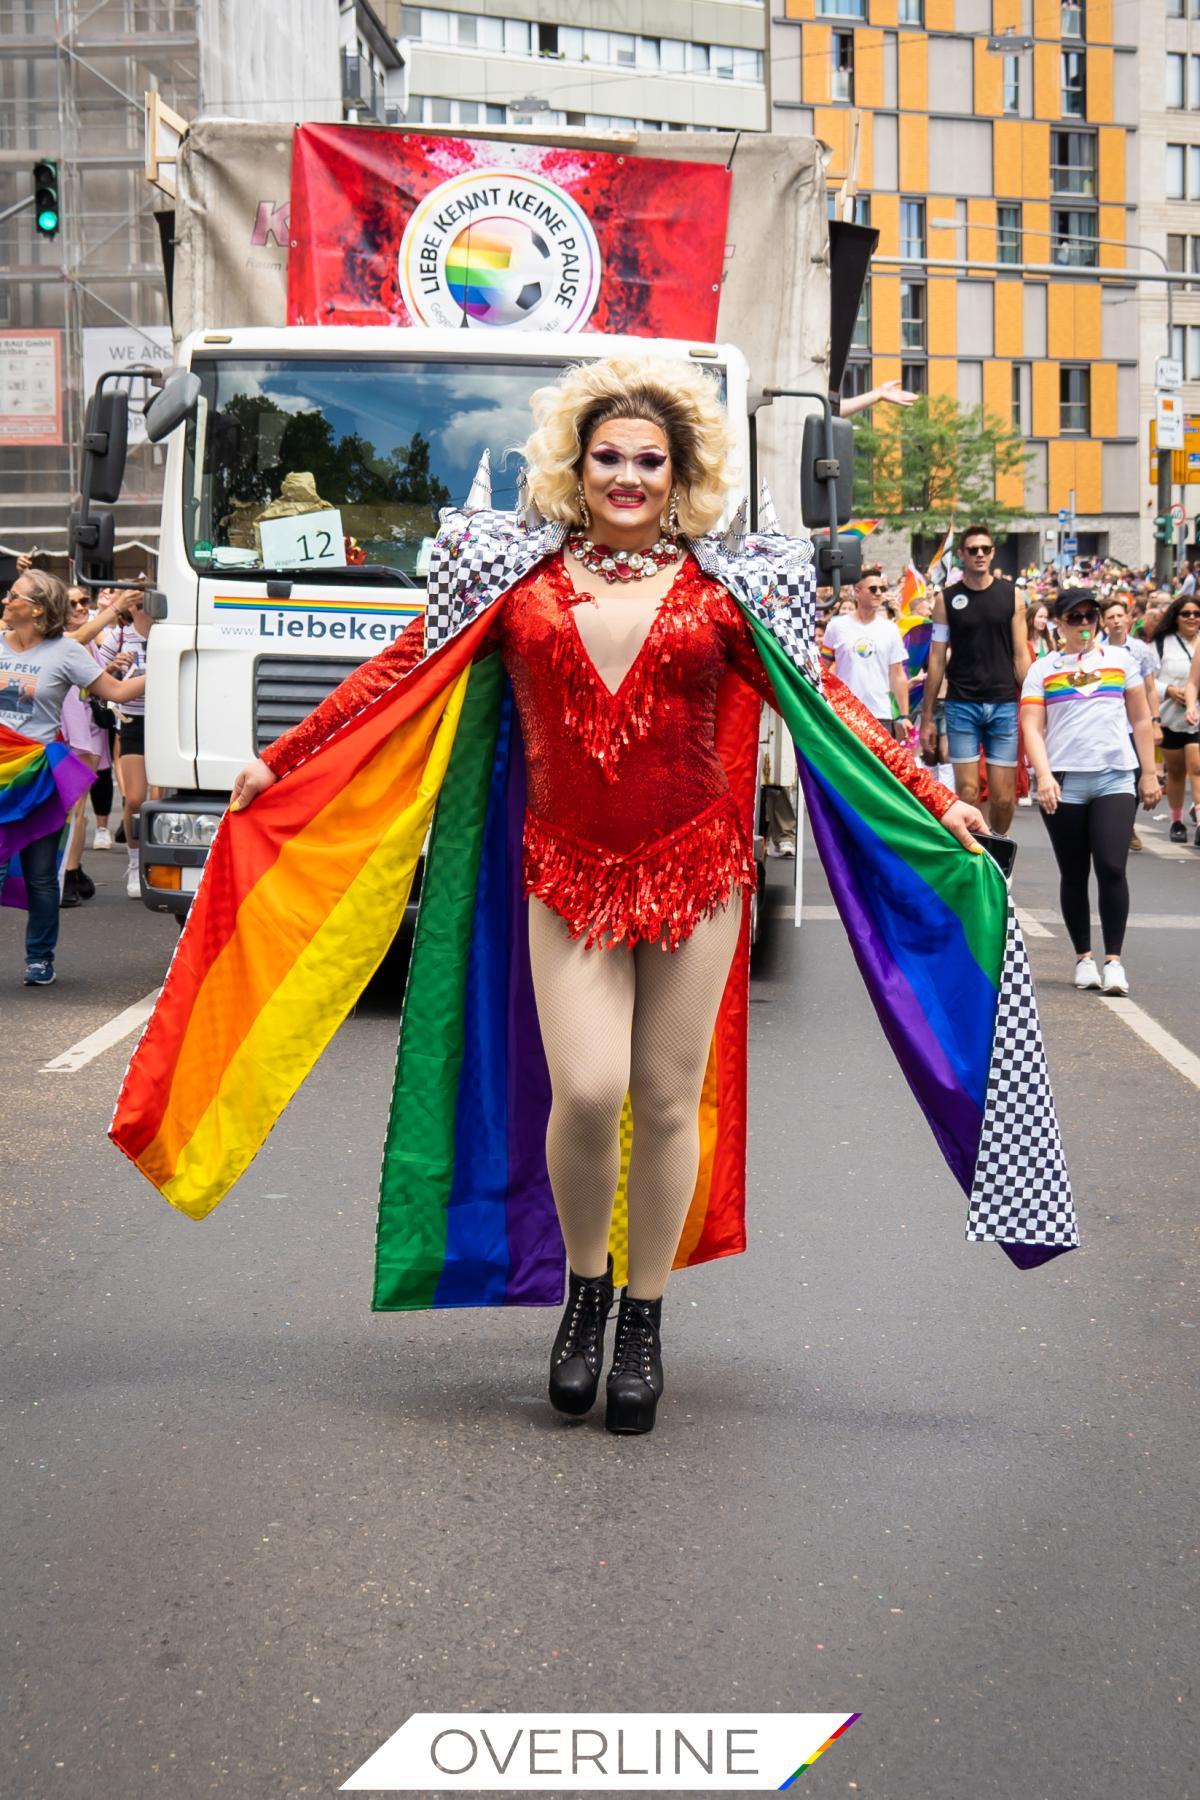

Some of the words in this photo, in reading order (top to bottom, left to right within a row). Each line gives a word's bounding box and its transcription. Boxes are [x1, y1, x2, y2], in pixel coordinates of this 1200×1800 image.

[420, 233, 442, 295] LIEBE
[433, 188, 501, 234] KENNT
[508, 189, 567, 236] KEINE
[554, 237, 580, 310] PAUSE
[109, 345, 135, 360] WE
[296, 531, 335, 562] 12
[14, 663, 41, 675] PEW
